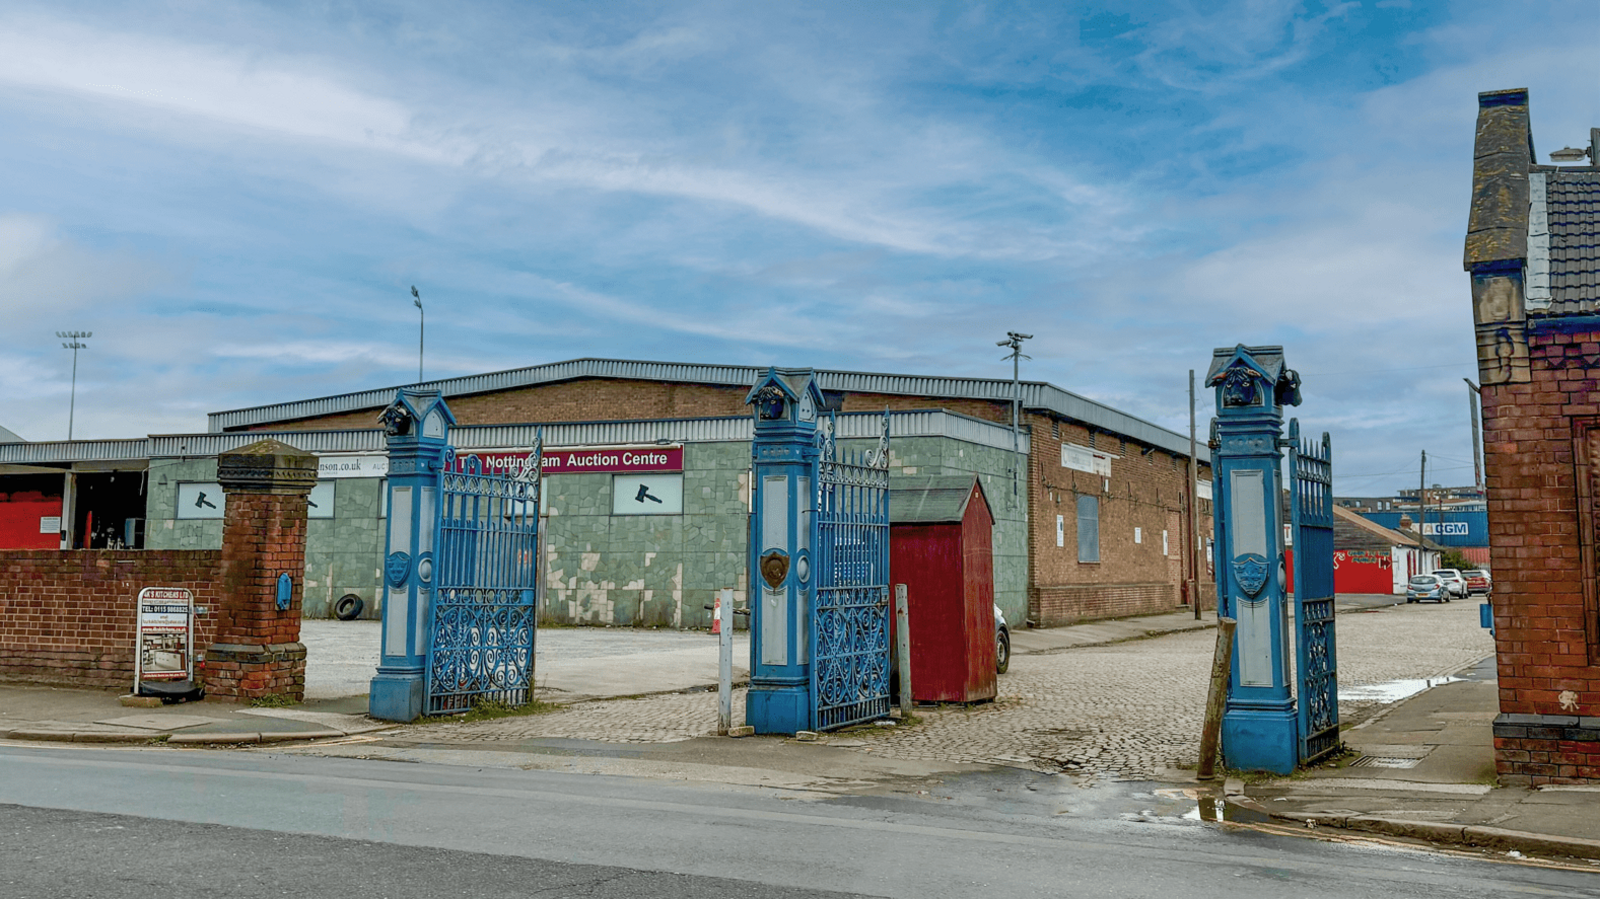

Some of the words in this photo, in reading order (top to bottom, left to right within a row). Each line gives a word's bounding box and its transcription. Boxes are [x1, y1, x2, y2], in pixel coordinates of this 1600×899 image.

[485, 455, 560, 470] Nottinam
[566, 453, 618, 467] Auction
[622, 452, 668, 465] Centre
[1435, 524, 1467, 533] CGM
